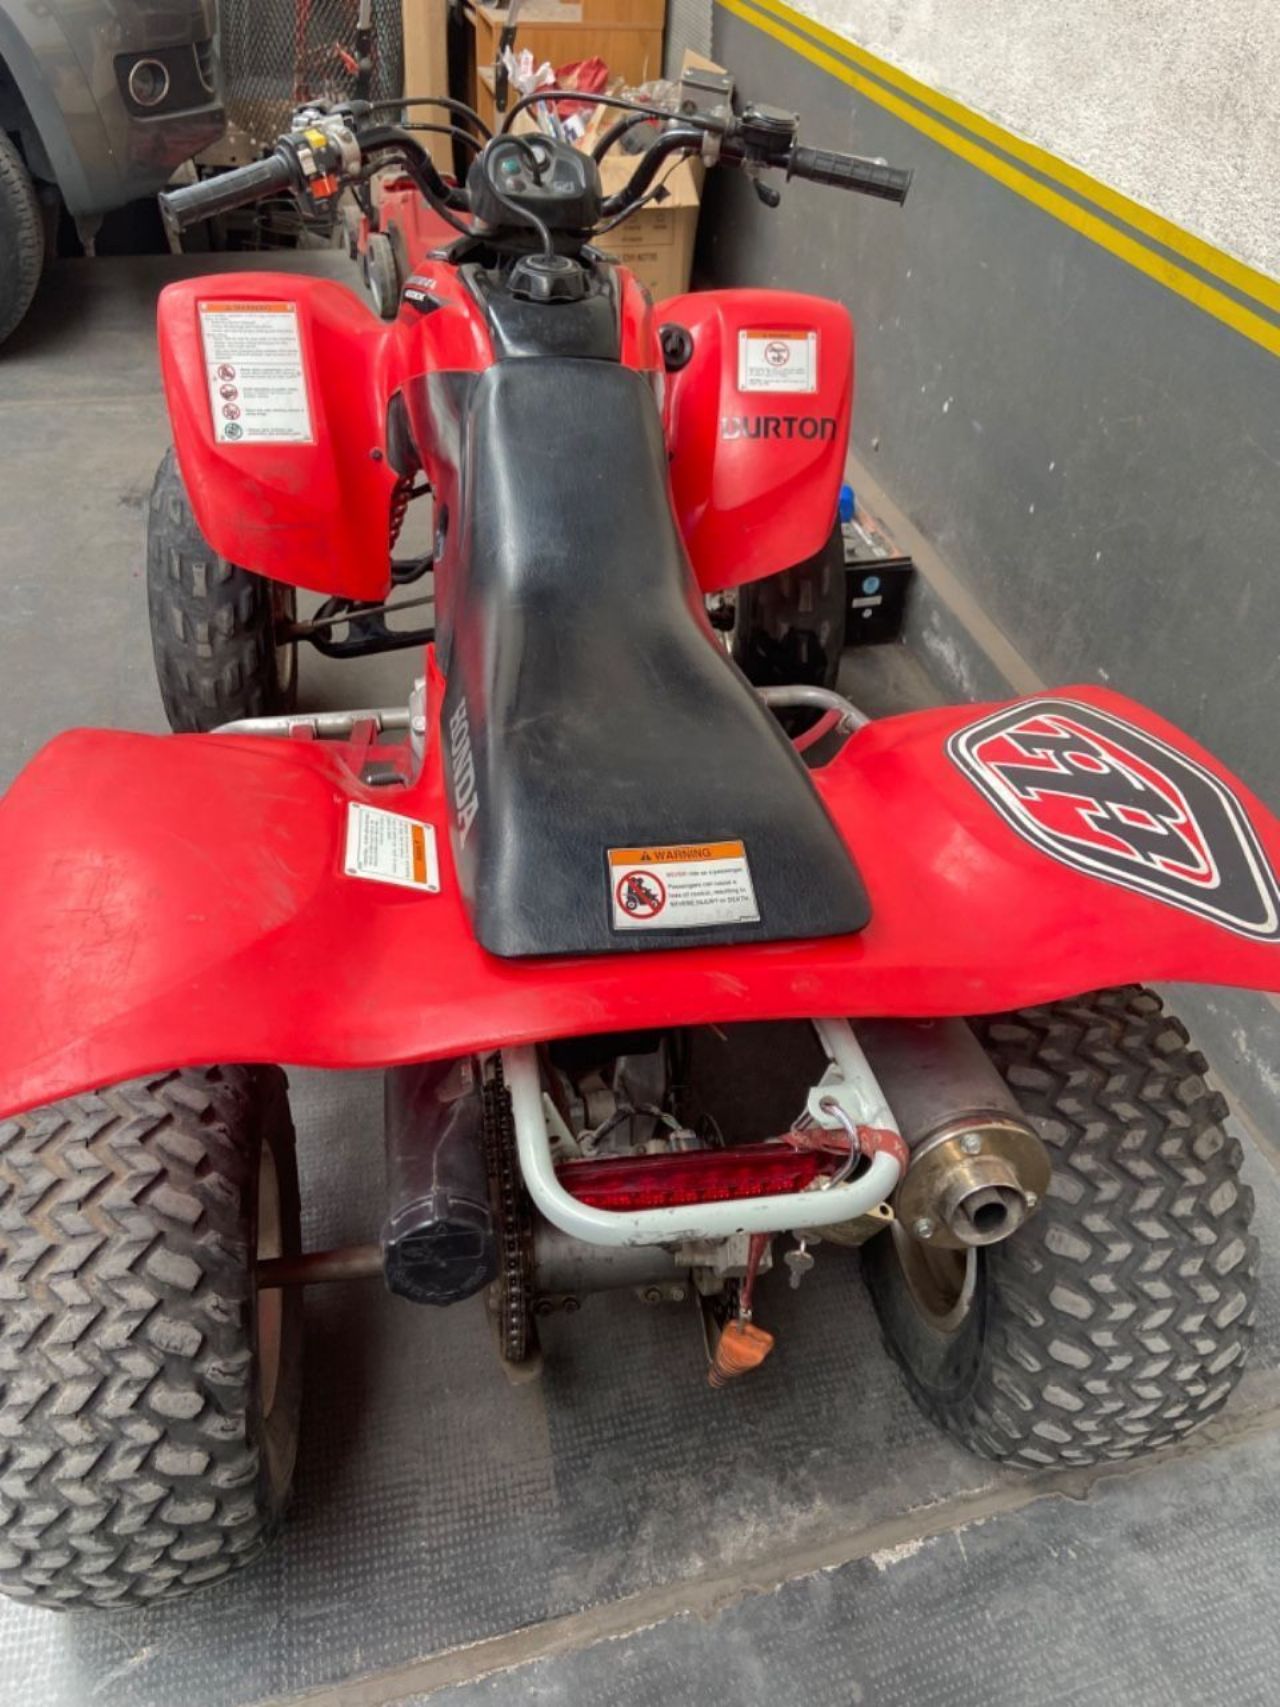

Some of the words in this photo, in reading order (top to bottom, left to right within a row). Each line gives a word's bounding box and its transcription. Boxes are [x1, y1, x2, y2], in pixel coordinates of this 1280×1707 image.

[721, 416, 837, 441] BURTON
[450, 696, 479, 850] HONDA
[655, 846, 712, 861] WARNING
